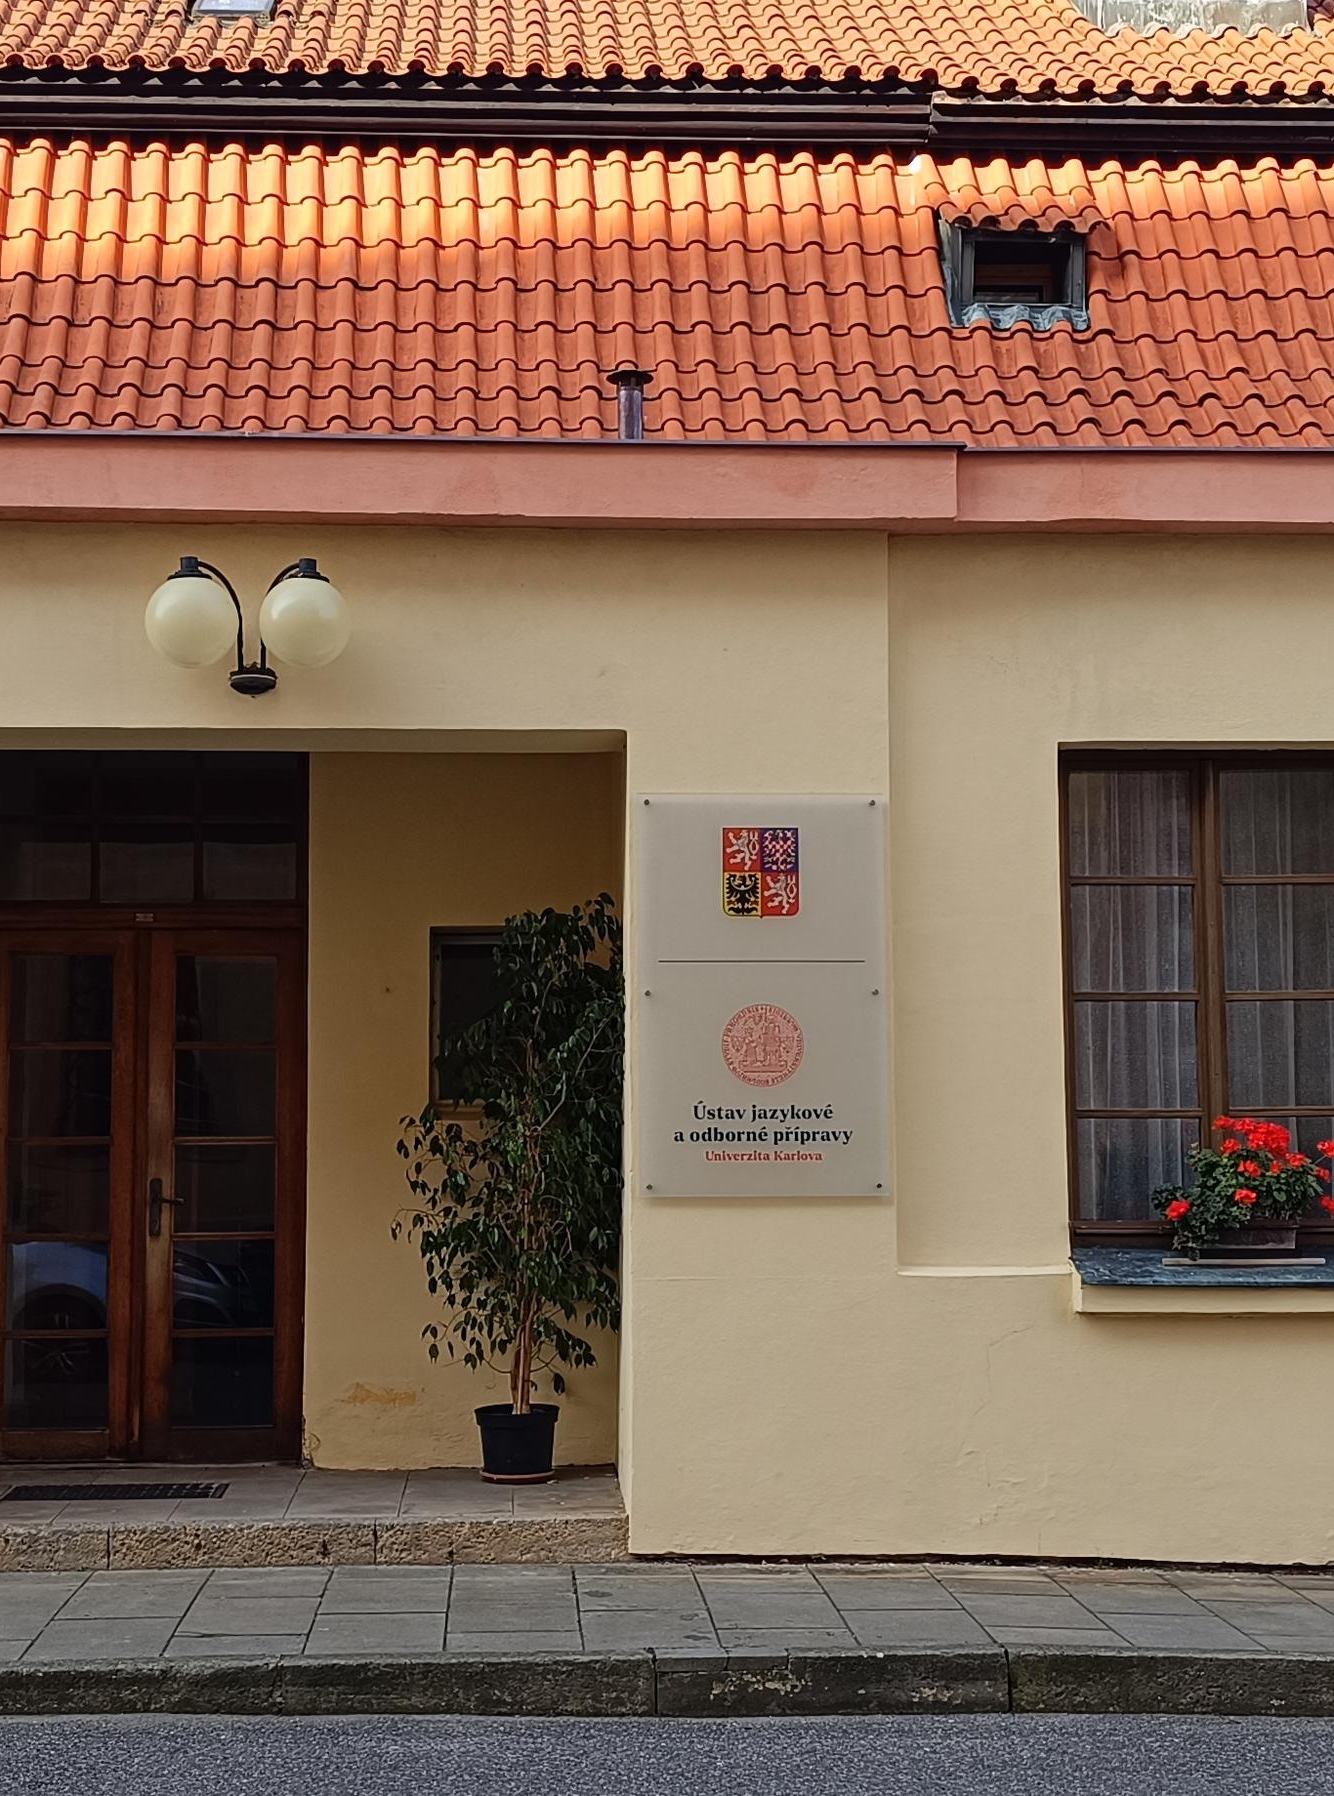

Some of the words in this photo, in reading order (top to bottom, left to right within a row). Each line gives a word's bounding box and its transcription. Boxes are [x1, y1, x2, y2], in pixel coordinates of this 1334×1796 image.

[693, 1100, 747, 1121] Ústav
[750, 1103, 834, 1124] jazykové
[673, 1130, 685, 1142] a
[689, 1126, 769, 1143] odborné
[772, 1126, 854, 1146] přípravy
[705, 1150, 771, 1162] Univerzita
[773, 1150, 823, 1162] Karlova
